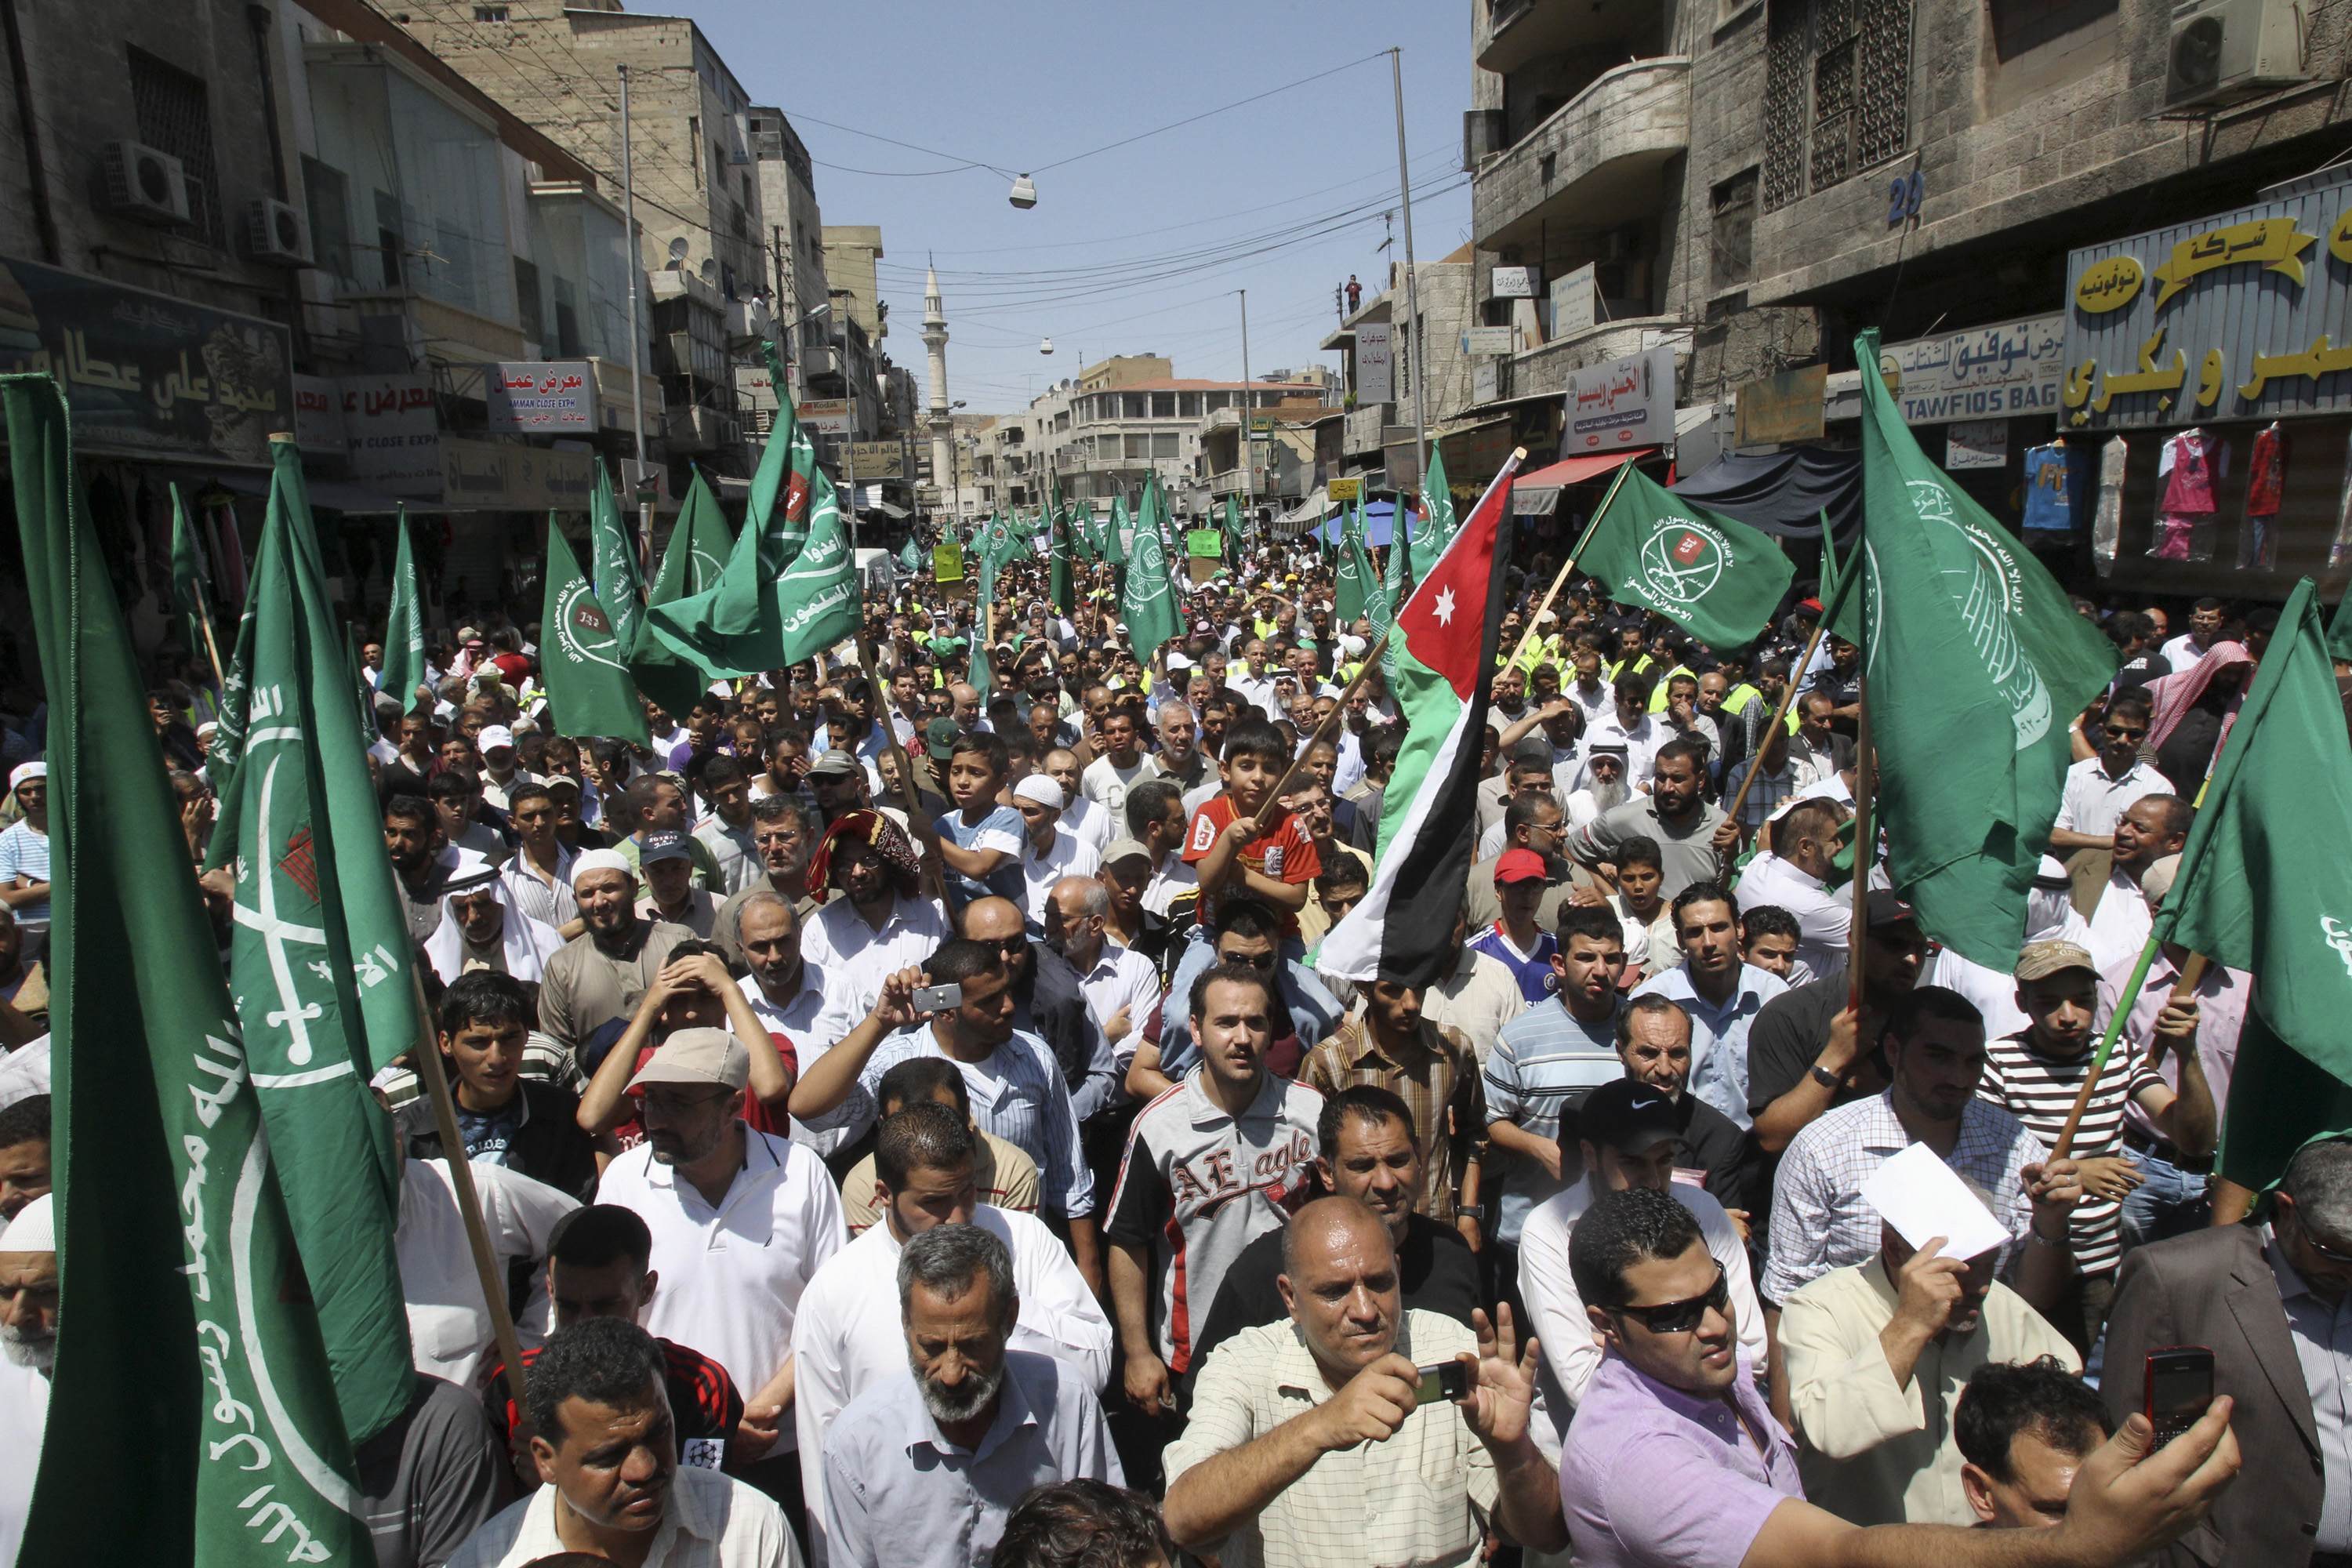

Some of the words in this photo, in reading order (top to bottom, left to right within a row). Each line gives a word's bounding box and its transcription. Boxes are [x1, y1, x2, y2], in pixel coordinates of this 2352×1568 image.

[1889, 170, 1923, 223] 29
[2190, 222, 2267, 260] شركة
[1952, 325, 2029, 380] توفيق
[153, 349, 209, 420] علي
[494, 368, 533, 394] عمان
[539, 368, 583, 394] معرض
[217, 376, 276, 412] محمد
[509, 399, 534, 408] AMMAN
[536, 399, 556, 408] CLOSE
[558, 398, 575, 408] EXPH
[1904, 390, 2003, 419] TAWFIQ'S
[2009, 383, 2056, 408] BAG
[367, 436, 403, 448] CLOSE
[880, 444, 899, 456] عالم
[1653, 517, 1664, 531] الله
[1665, 515, 1688, 525] رسول
[1689, 520, 1712, 533] محمد
[1711, 529, 1724, 542] الله
[1965, 523, 1998, 547] محمد
[1997, 548, 2015, 567] الله
[2008, 568, 2023, 583] إلا
[557, 589, 569, 604] الله
[1624, 575, 1659, 601] المسلمون
[783, 582, 851, 633] المسلمون
[557, 631, 574, 653] رسول
[568, 652, 583, 663] الله
[175, 1134, 211, 1303] محمد
[196, 1318, 272, 1472] رسول
[236, 1483, 333, 1563] الله
